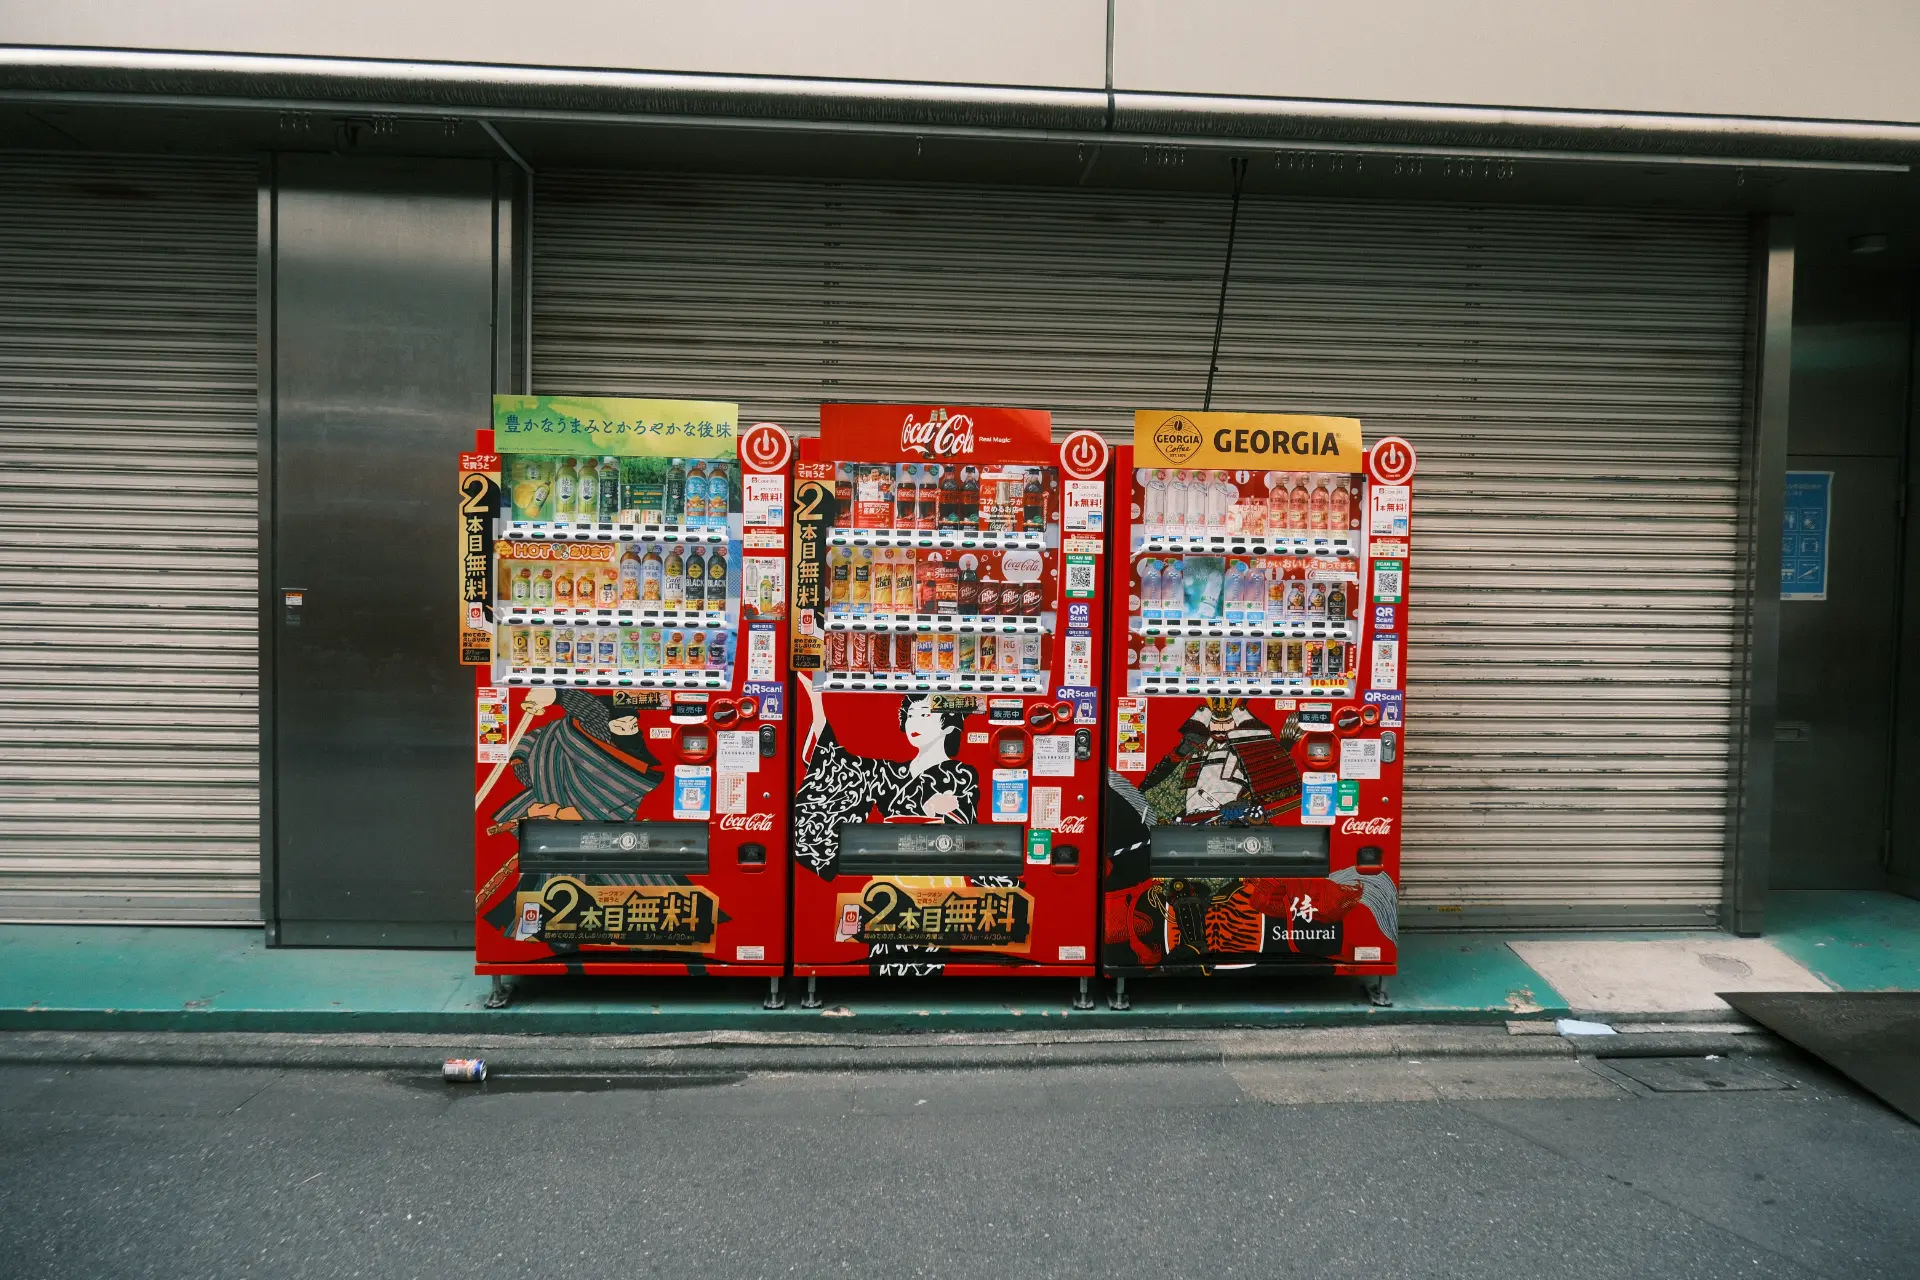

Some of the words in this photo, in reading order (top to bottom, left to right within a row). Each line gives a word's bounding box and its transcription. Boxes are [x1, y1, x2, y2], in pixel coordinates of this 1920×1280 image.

[504, 414, 732, 438] 豊かなうまみとかろやかな後味
[1156, 434, 1200, 444] GEORGIA
[1213, 428, 1340, 456] GEORGIA
[1165, 444, 1191, 453] Coffee
[798, 463, 832, 471] コークオン
[746, 485, 782, 502] 1本無料!
[1066, 491, 1102, 508] 1本無料!
[1373, 496, 1407, 512] 1本無料!
[463, 474, 488, 600] 2本目無料
[798, 483, 823, 607] 2本目無料
[515, 543, 551, 558] HOT
[569, 544, 613, 559] あります
[1003, 559, 1040, 572] Coca-Cola
[1070, 605, 1088, 615] QR
[1375, 607, 1393, 617] QR
[743, 684, 760, 694] QR
[760, 685, 782, 693] Scan!
[1058, 688, 1075, 698] QR
[1364, 692, 1381, 701] QR
[1381, 693, 1402, 701] Scan!
[616, 691, 659, 705] 2本目無料
[932, 695, 974, 709] 2本目無料
[993, 710, 1019, 718] 販売中
[720, 812, 775, 831] Coca-Cola
[1341, 817, 1393, 835] Coca-Cola
[545, 883, 699, 932] 2本目無料
[865, 884, 1015, 933] 2本目無料
[1289, 894, 1319, 924] 侍
[1272, 925, 1336, 941] Samurai
